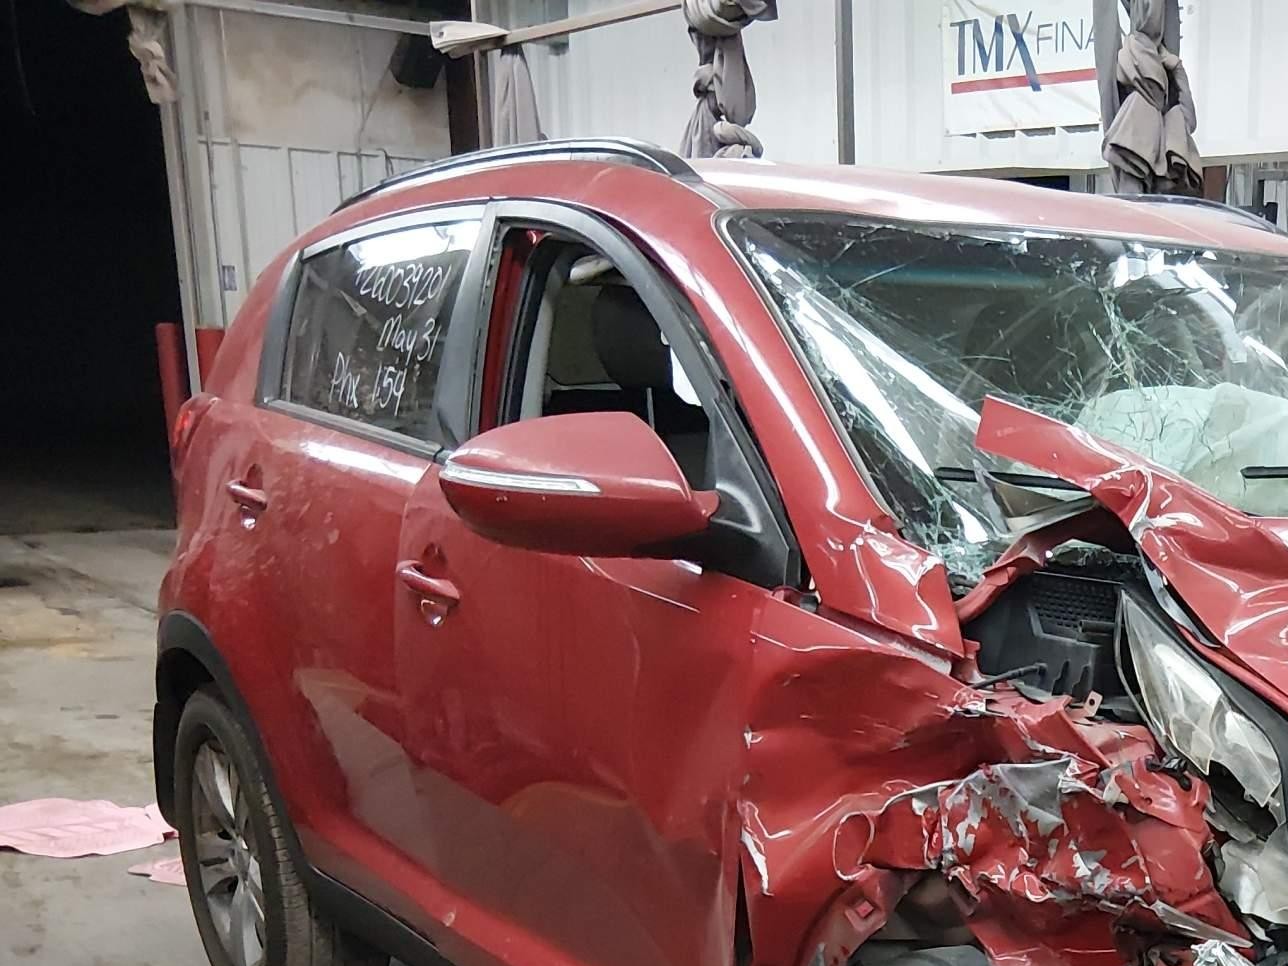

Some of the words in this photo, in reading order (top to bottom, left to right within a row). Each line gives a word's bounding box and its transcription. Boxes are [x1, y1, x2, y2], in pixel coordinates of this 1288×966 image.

[950, 11, 1041, 91] TMX
[376, 314, 418, 366] May
[417, 317, 442, 362] 31
